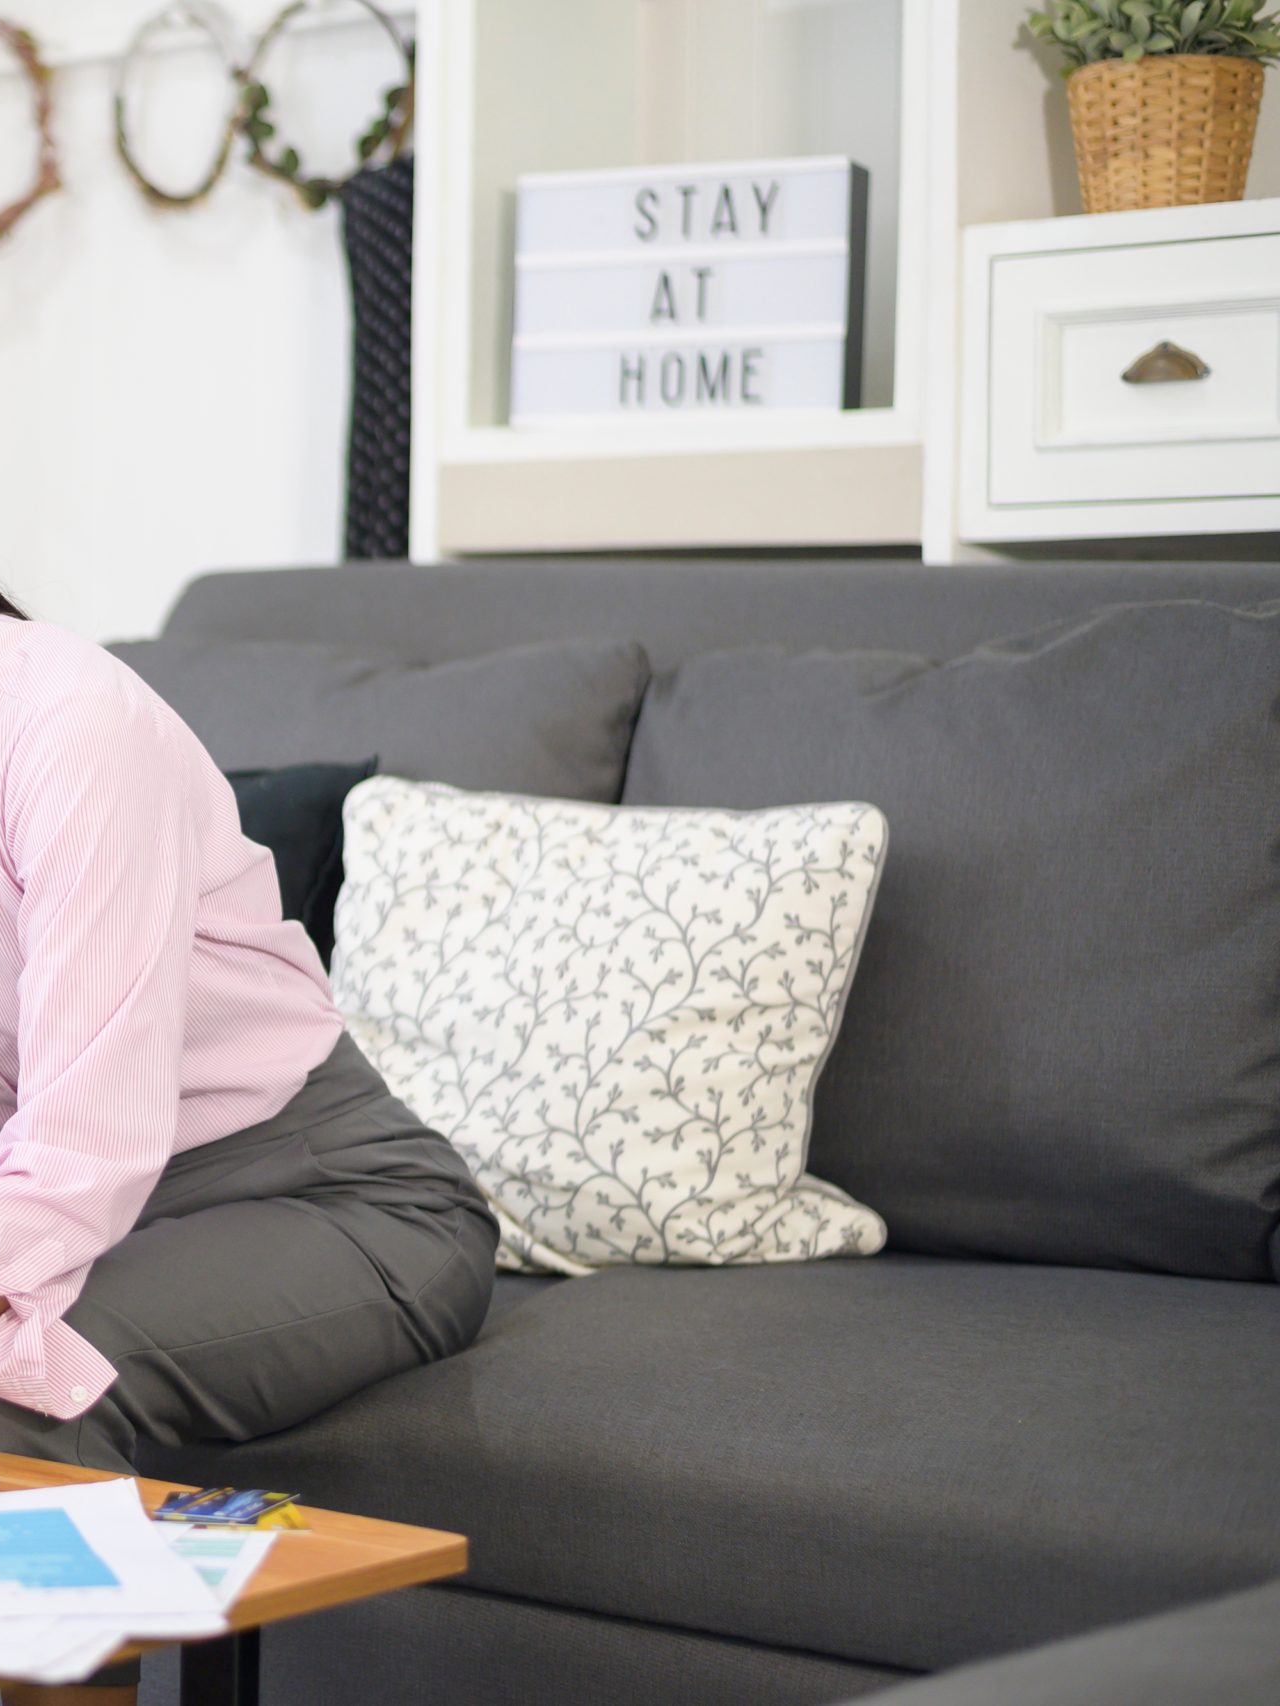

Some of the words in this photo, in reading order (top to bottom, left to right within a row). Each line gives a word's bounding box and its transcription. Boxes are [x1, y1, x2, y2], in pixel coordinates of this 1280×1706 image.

[633, 181, 779, 241] STAY
[649, 267, 713, 322] AT
[619, 347, 764, 405] HOME
